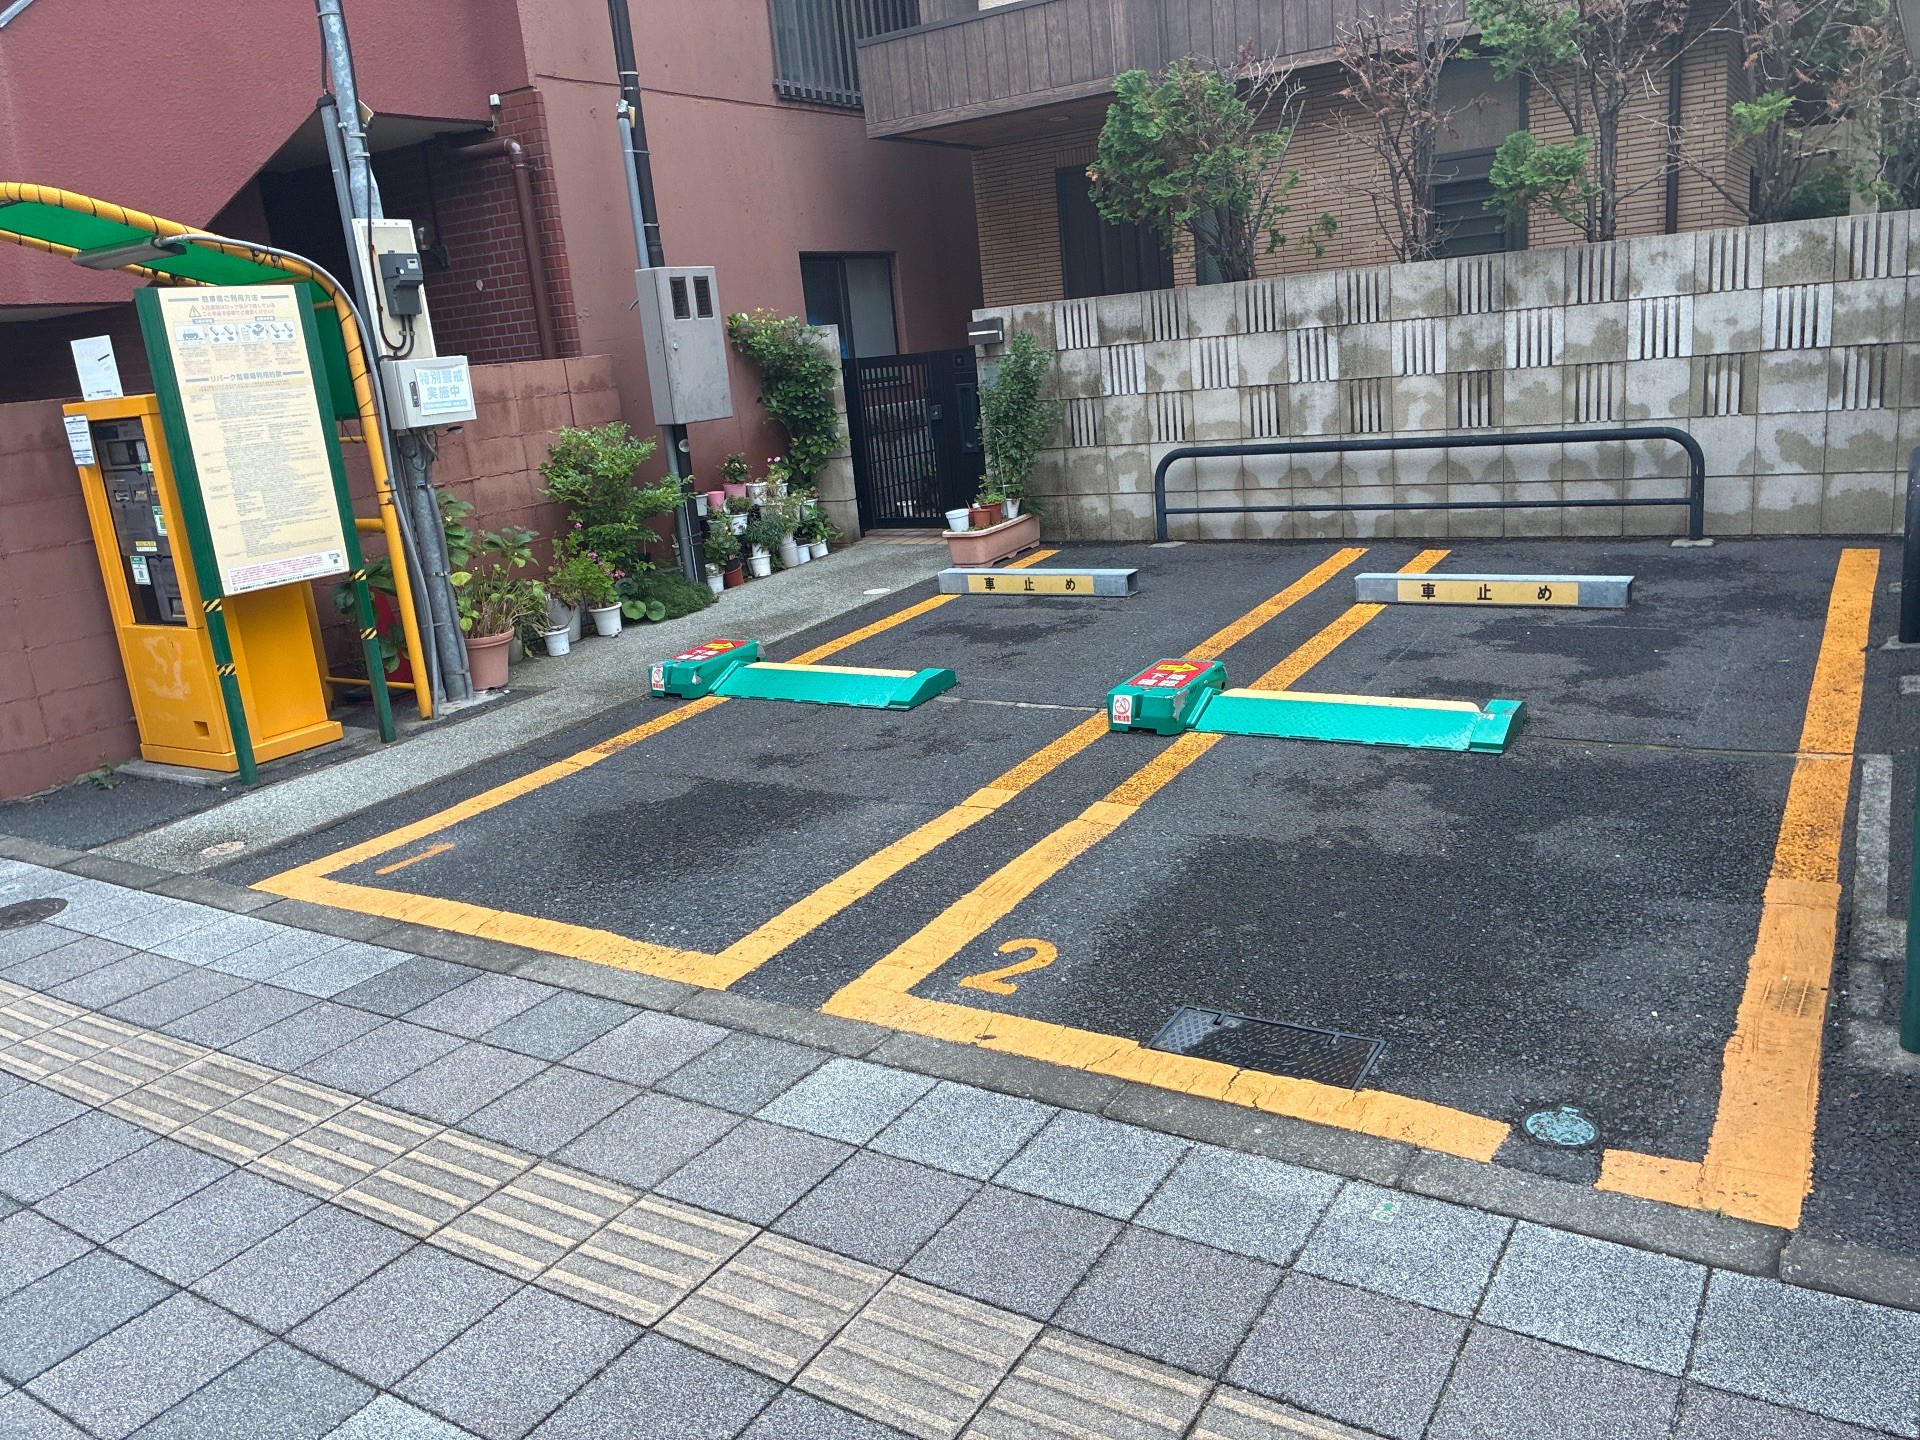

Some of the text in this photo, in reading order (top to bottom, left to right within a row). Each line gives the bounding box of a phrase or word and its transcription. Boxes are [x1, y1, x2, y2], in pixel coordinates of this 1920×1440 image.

[427, 385, 460, 399] 実施中
[984, 577, 1076, 591] 車止め
[1421, 583, 1552, 602] 車止め
[959, 937, 1060, 996] 2
